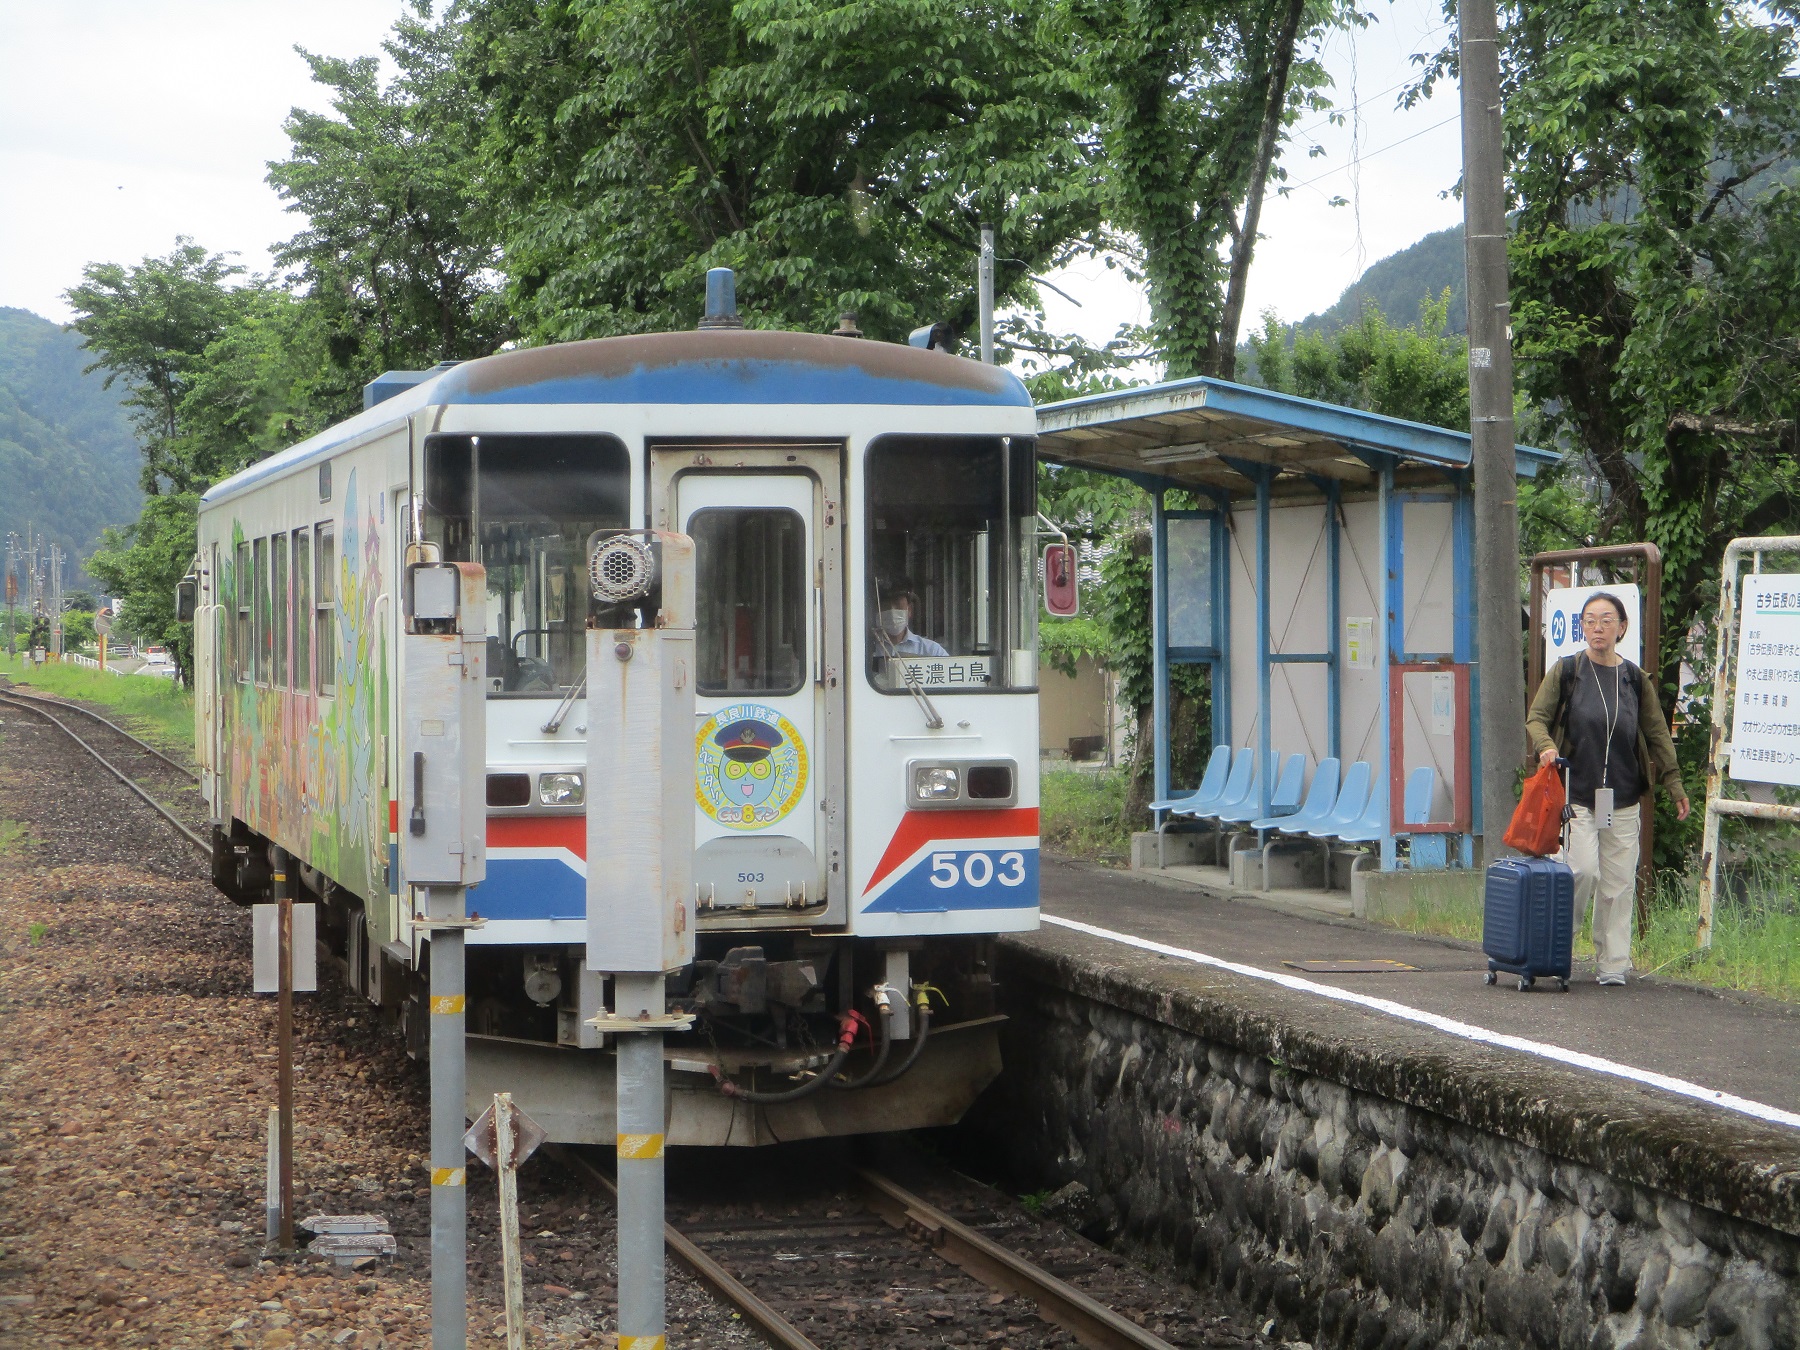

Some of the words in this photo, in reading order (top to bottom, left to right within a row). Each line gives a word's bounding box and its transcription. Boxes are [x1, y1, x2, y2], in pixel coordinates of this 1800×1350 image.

[1553, 617, 1564, 640] 29
[904, 661, 988, 686] 美濃白鳥
[1745, 668, 1800, 683] やまと温泉「やすらぎ
[715, 705, 780, 726] 長良川鉄道
[737, 872, 765, 883] 503
[929, 852, 1026, 888] 503
